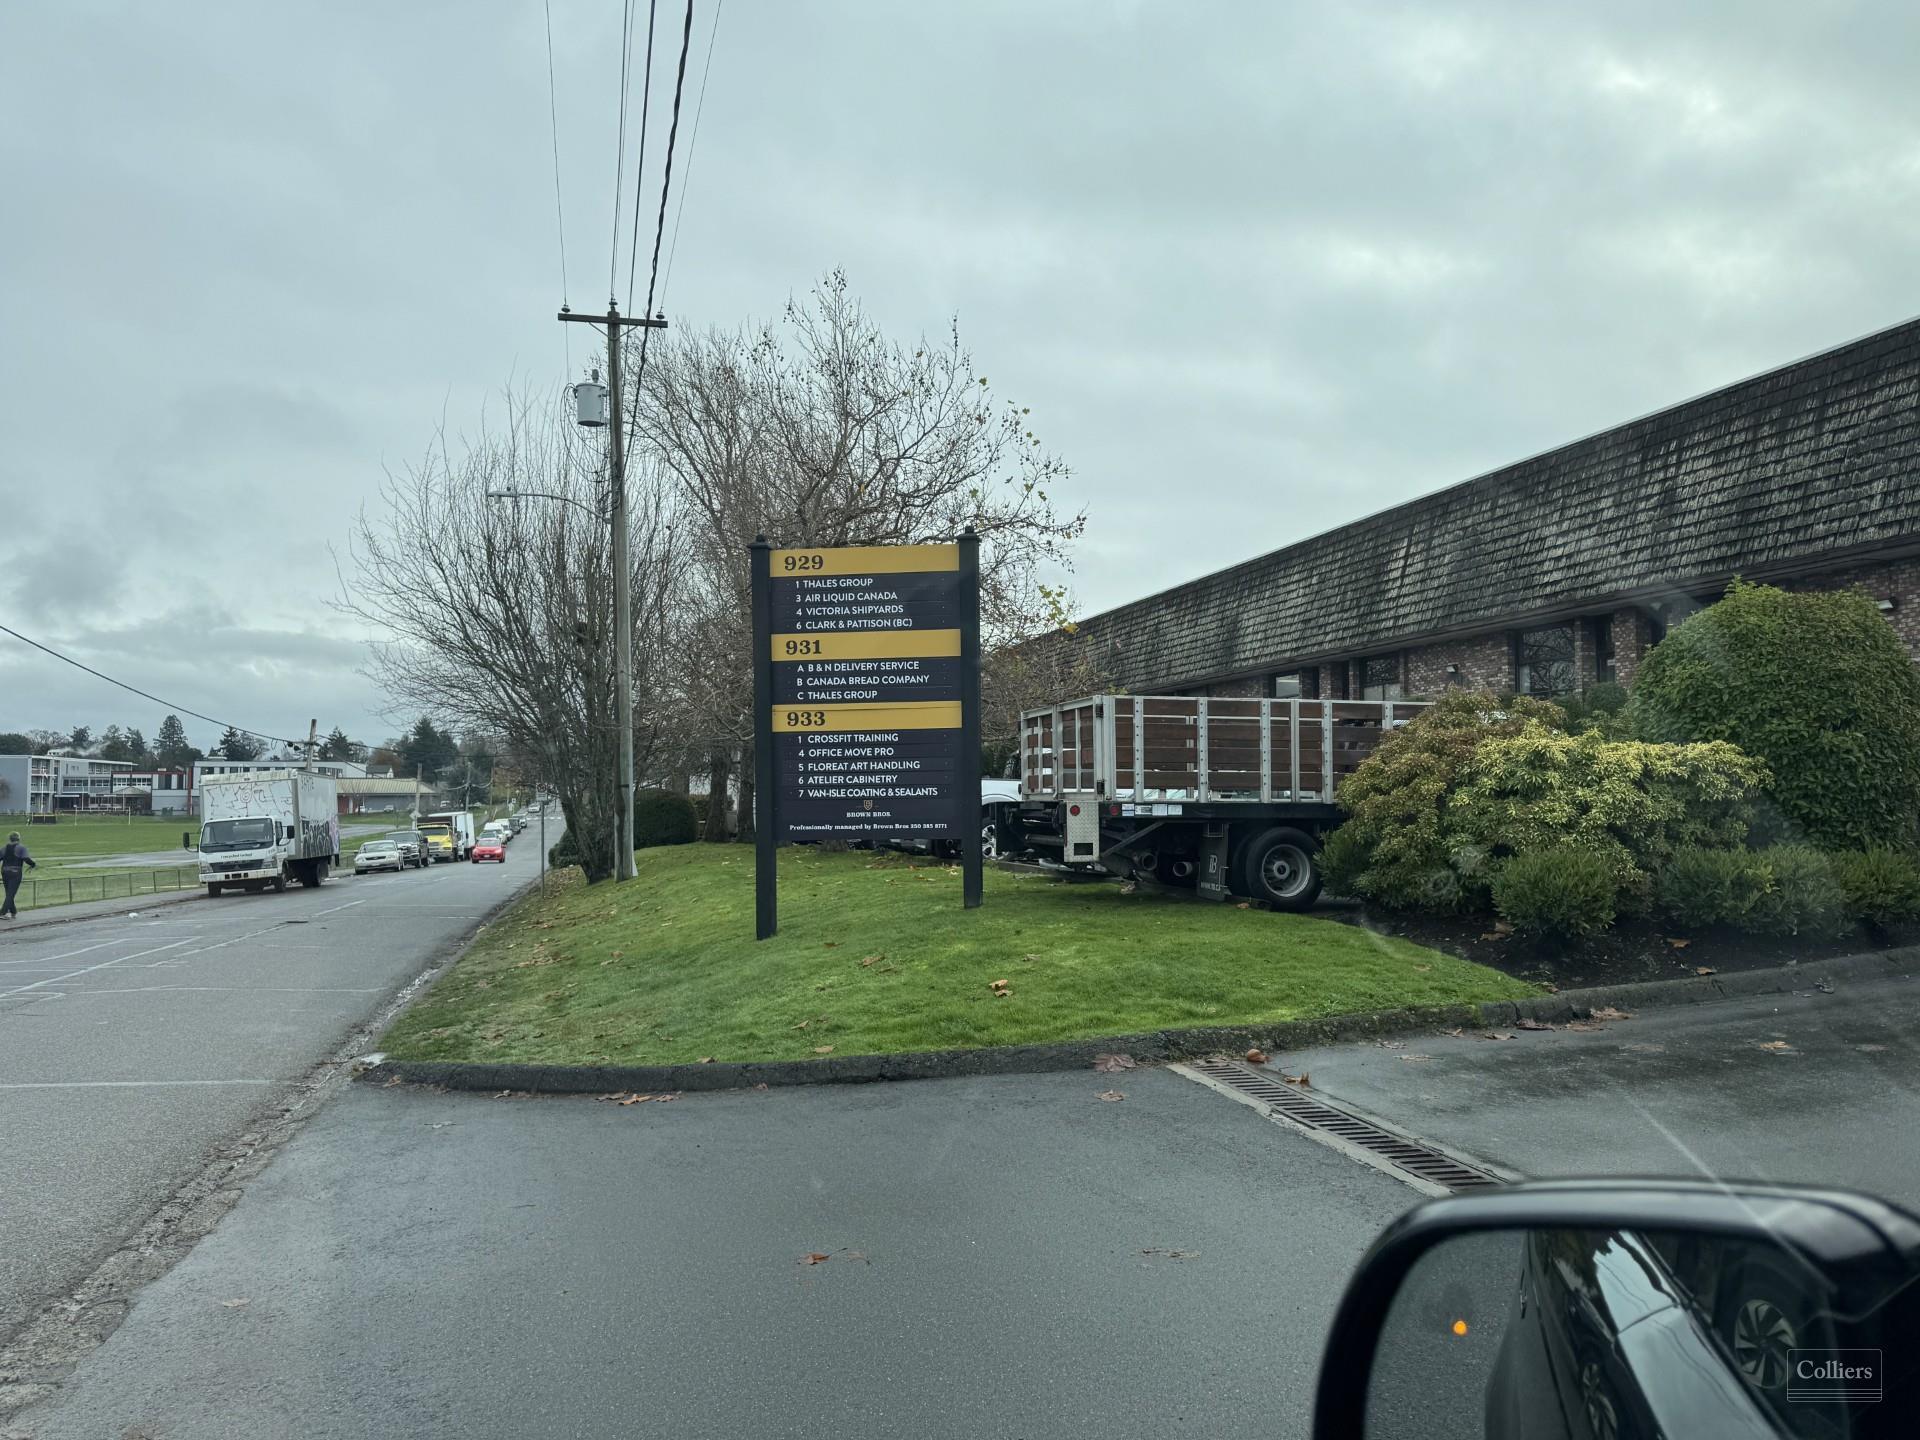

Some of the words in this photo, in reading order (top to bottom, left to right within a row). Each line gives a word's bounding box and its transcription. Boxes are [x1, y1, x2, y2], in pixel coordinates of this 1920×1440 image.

[784, 555, 823, 571] 929
[803, 580, 837, 588] THALES
[839, 579, 873, 587] GROUP
[805, 594, 821, 602] AIR
[823, 593, 855, 603] LIQUID
[857, 592, 897, 600] CANADA
[806, 607, 850, 615] VICTORIA
[852, 605, 904, 614] SHIPYARDS
[806, 621, 836, 629] CLARK
[838, 620, 845, 628] &
[847, 620, 891, 628] PATTISON
[893, 619, 912, 627] (BC)
[786, 640, 822, 655] 931
[808, 664, 814, 672] B
[825, 663, 832, 671] N
[835, 662, 878, 671] DELIVERY
[881, 662, 919, 670] SERVICE
[797, 678, 802, 686] B
[807, 677, 846, 686] CANADA
[849, 676, 879, 684] BREAD
[882, 675, 929, 683] COMPANY
[797, 692, 804, 700] C
[808, 691, 842, 699] THALES
[844, 691, 877, 699] GROUP
[787, 712, 825, 726] 933
[808, 734, 852, 743] CROSSFIT
[853, 733, 898, 742] TRAINING
[799, 749, 804, 757] 4
[809, 749, 842, 757] OFFICE
[845, 748, 871, 756] MOVE
[875, 748, 894, 756] PRO
[808, 762, 849, 771] FLOREAT
[851, 762, 868, 770] ART
[870, 761, 920, 769] HANDLING
[808, 776, 844, 784] ATELIER
[846, 775, 897, 783] CABINETRY
[799, 790, 803, 798] 7
[808, 789, 846, 797] VAN-ISLE
[847, 788, 886, 797] COATING
[895, 787, 938, 796] SEALANTS
